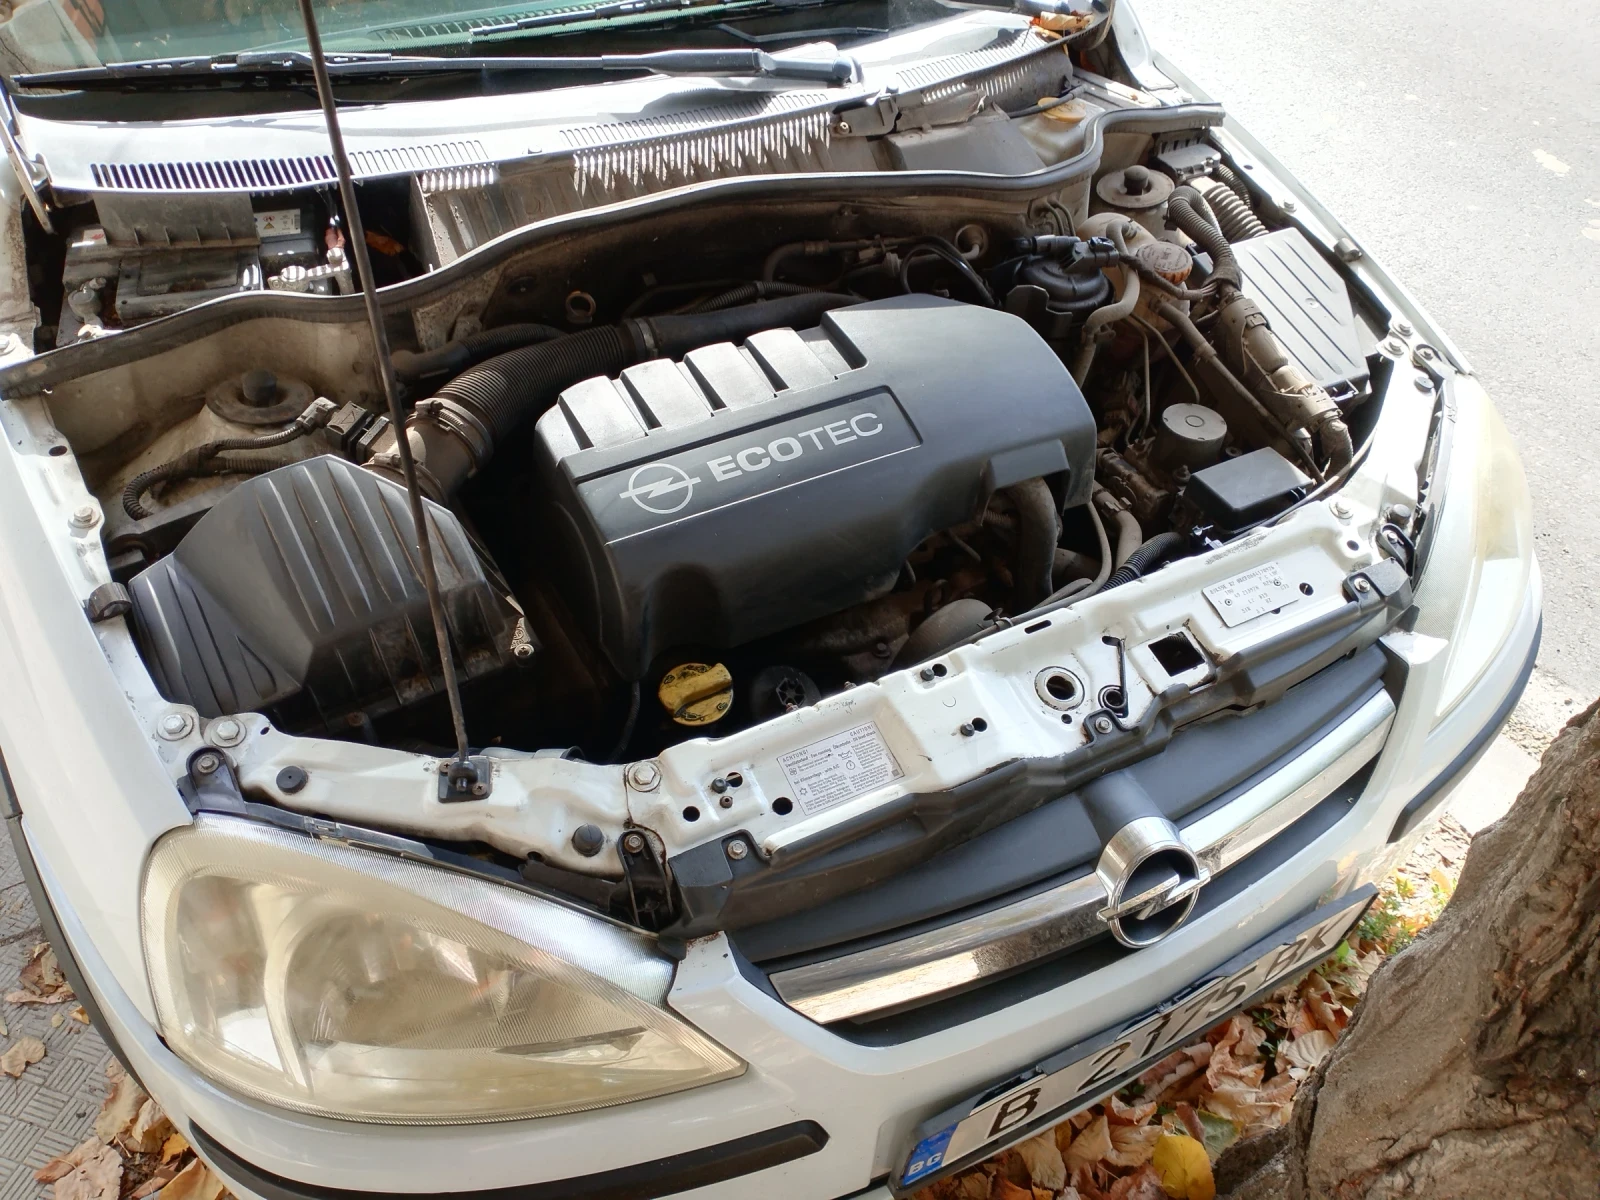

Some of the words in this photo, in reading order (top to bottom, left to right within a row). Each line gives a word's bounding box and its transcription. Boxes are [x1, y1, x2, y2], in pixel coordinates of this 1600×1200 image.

[706, 412, 884, 482] ECOTEC
[782, 750, 808, 762] ACHTUNG!
[986, 1086, 1042, 1139] B
[907, 1150, 943, 1176] BG
